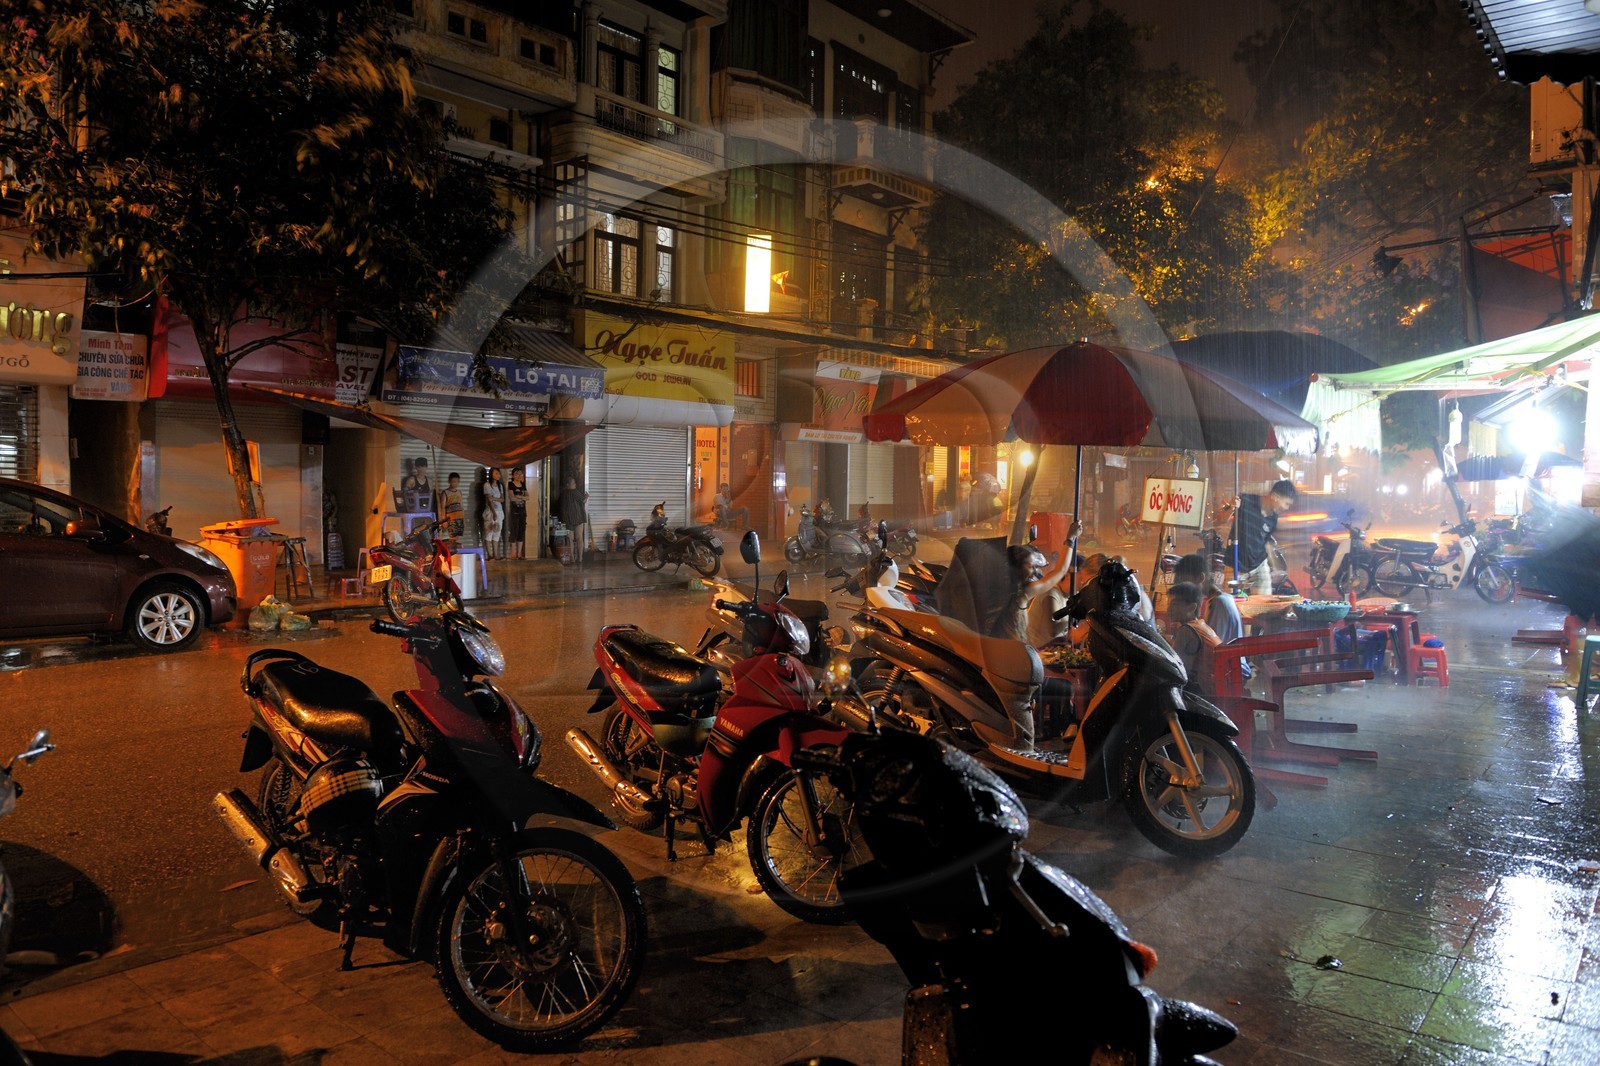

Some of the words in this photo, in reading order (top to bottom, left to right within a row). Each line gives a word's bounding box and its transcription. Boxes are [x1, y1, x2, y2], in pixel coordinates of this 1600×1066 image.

[88, 338, 111, 350] Minh
[595, 330, 663, 366] Ngọc
[667, 340, 728, 371] Tuấn
[336, 364, 374, 384] ST
[456, 362, 507, 381] BM
[546, 372, 577, 388] TAI
[636, 371, 657, 383] GOLD
[696, 440, 717, 449] HOTEL
[1149, 484, 1163, 511] ỐC
[1166, 487, 1194, 514] NÓNG
[720, 717, 745, 738] YAMAHA
[422, 771, 450, 784] HONDA
